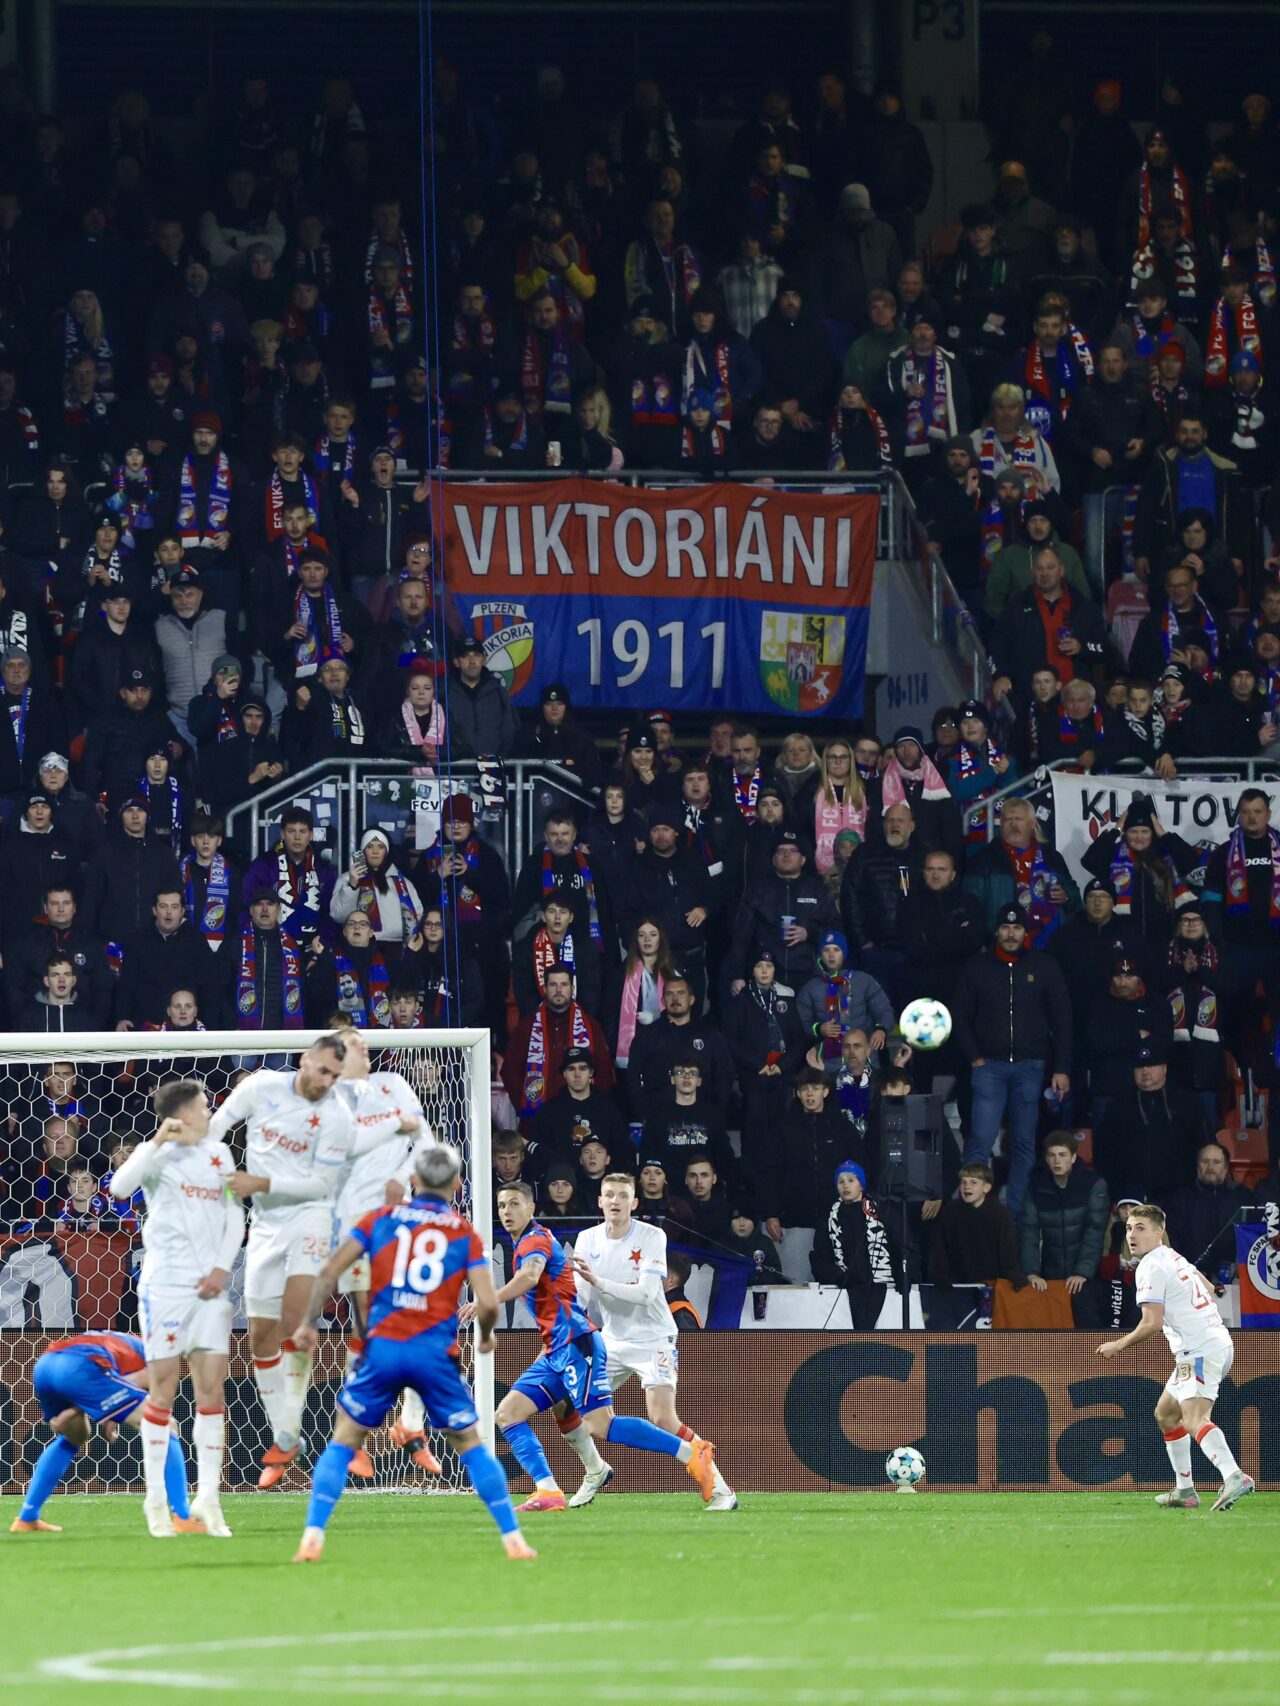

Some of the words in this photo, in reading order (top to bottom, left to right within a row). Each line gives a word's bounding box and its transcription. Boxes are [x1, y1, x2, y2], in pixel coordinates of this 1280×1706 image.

[272, 512, 285, 529] FC
[453, 497, 852, 588] VIKTORIÁNI
[577, 618, 726, 689] 1911
[822, 809, 839, 828] FC
[1081, 788, 1277, 828] KLTOV
[391, 1223, 450, 1294] 18
[565, 1365, 578, 1387] 3
